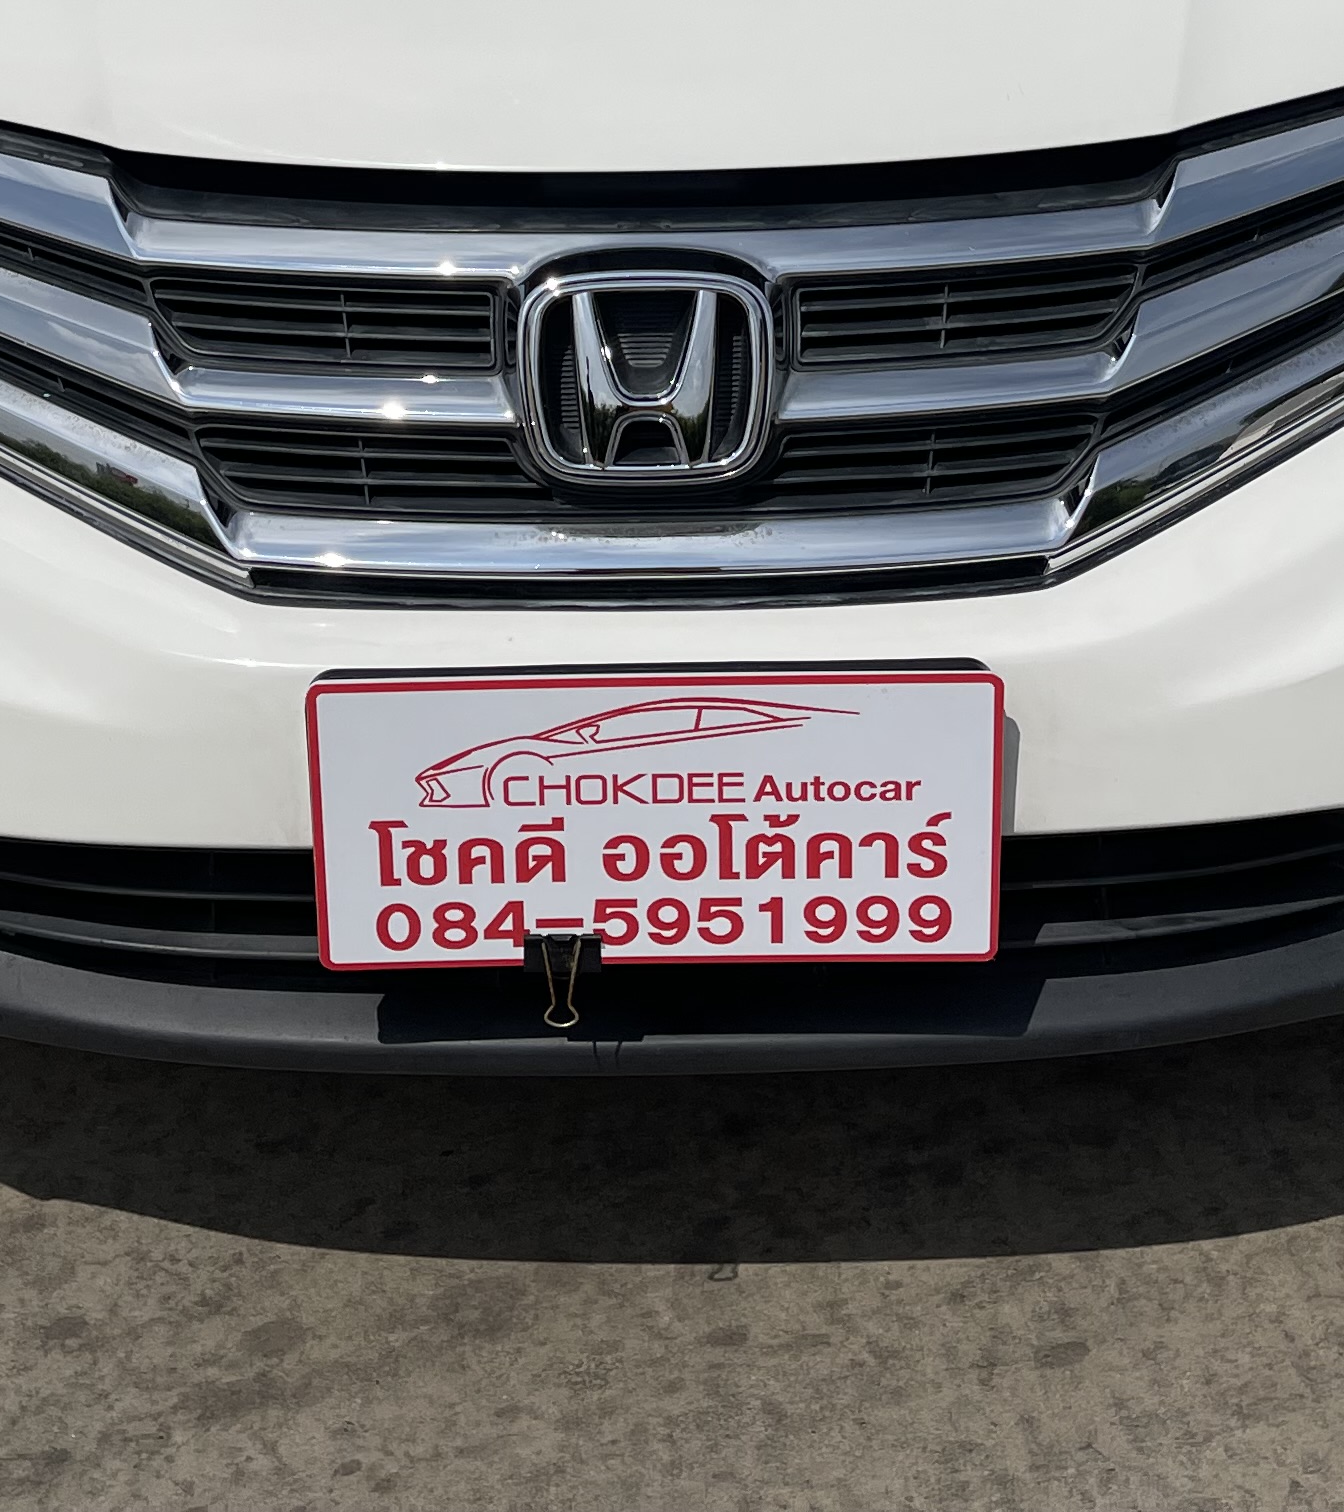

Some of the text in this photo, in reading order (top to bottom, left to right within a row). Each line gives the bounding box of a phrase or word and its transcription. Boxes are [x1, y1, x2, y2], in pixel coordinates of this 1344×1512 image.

[502, 771, 921, 807] CHOKDEE Autocar
[368, 811, 952, 887] โชคดี ออโต้คาร์
[375, 894, 953, 952] 084-5951999
